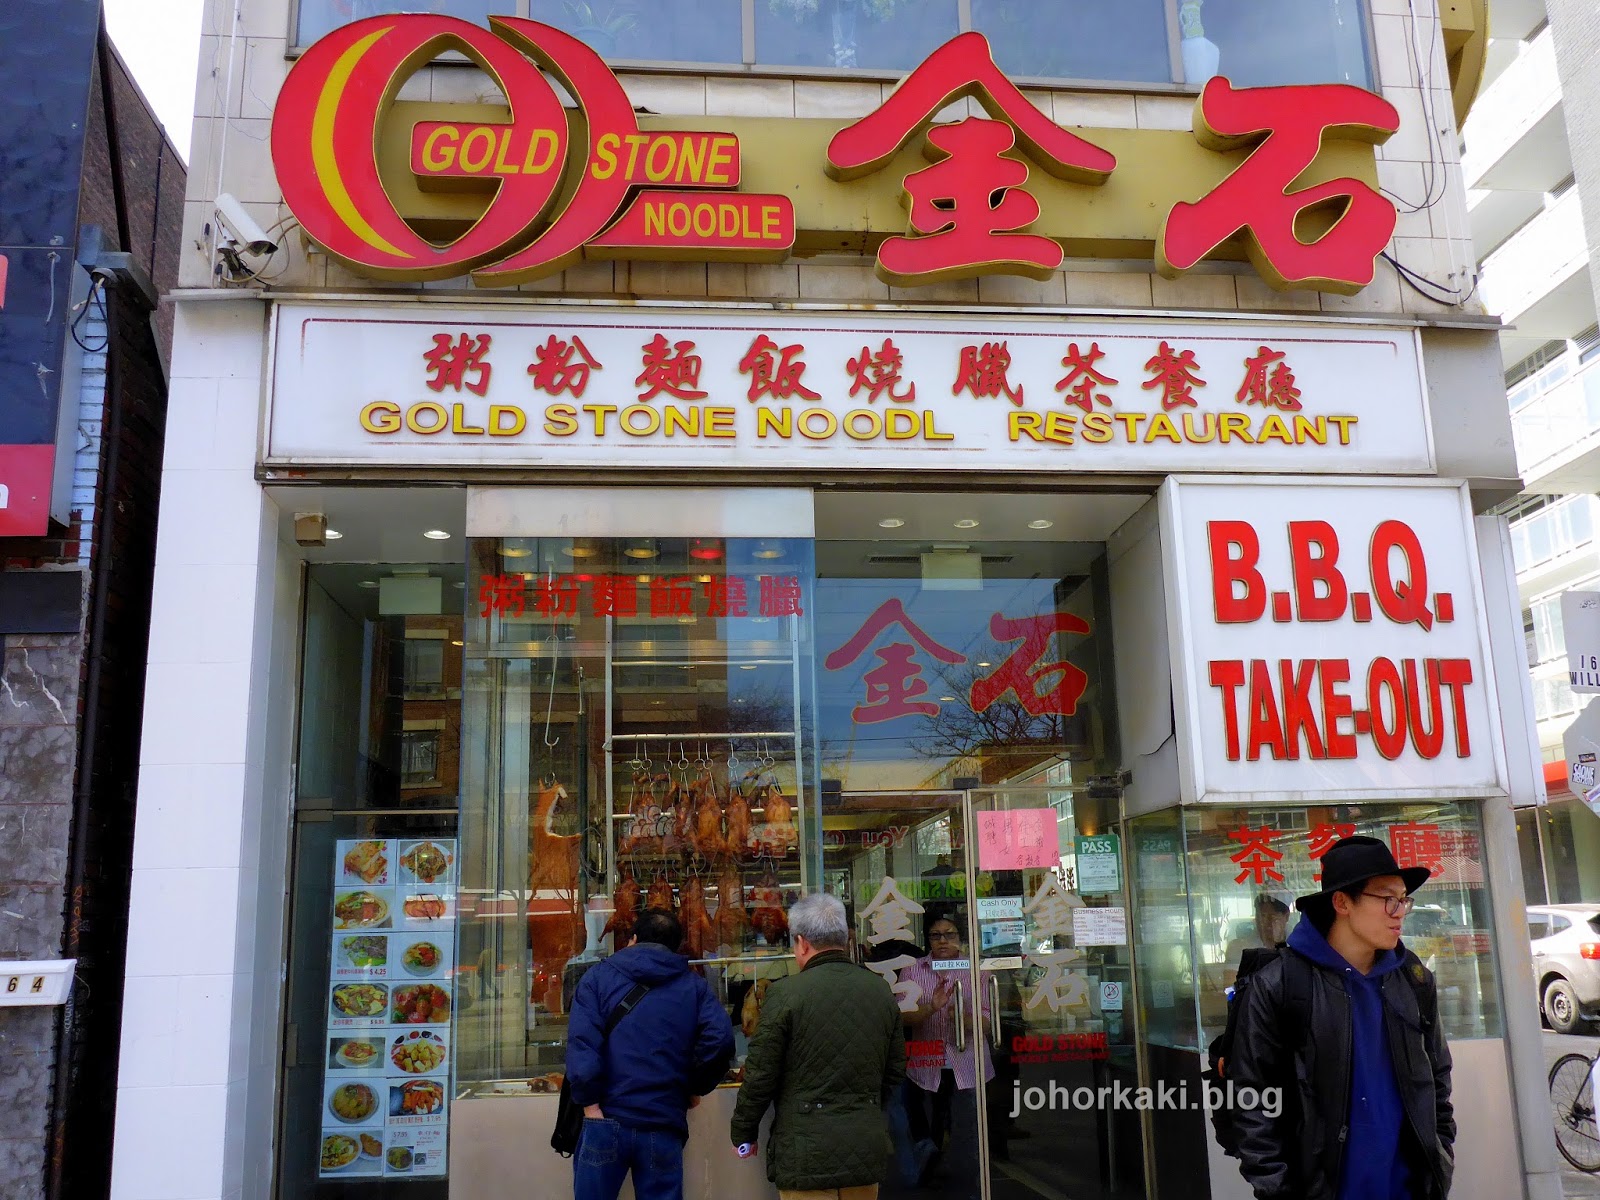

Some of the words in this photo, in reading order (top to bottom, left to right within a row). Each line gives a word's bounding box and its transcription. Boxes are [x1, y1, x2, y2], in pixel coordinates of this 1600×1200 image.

[422, 126, 560, 175] GOLD
[591, 132, 737, 184] STONE
[826, 31, 1400, 294] 金石
[644, 202, 782, 240] NOODLE
[359, 401, 527, 437] GOLD
[543, 404, 737, 439] STONE
[757, 407, 955, 442] NOODL
[1008, 410, 1358, 446] RESTAURANT
[1206, 519, 1455, 632] B.B.Q.
[825, 597, 1092, 725] 金石
[1208, 656, 1473, 761] TAKE-OUT
[1081, 840, 1112, 854] PASS
[980, 899, 1000, 907] Cash
[1001, 899, 1018, 908] Only
[1012, 1035, 1053, 1053] GOLD
[1057, 1032, 1108, 1051] STONE
